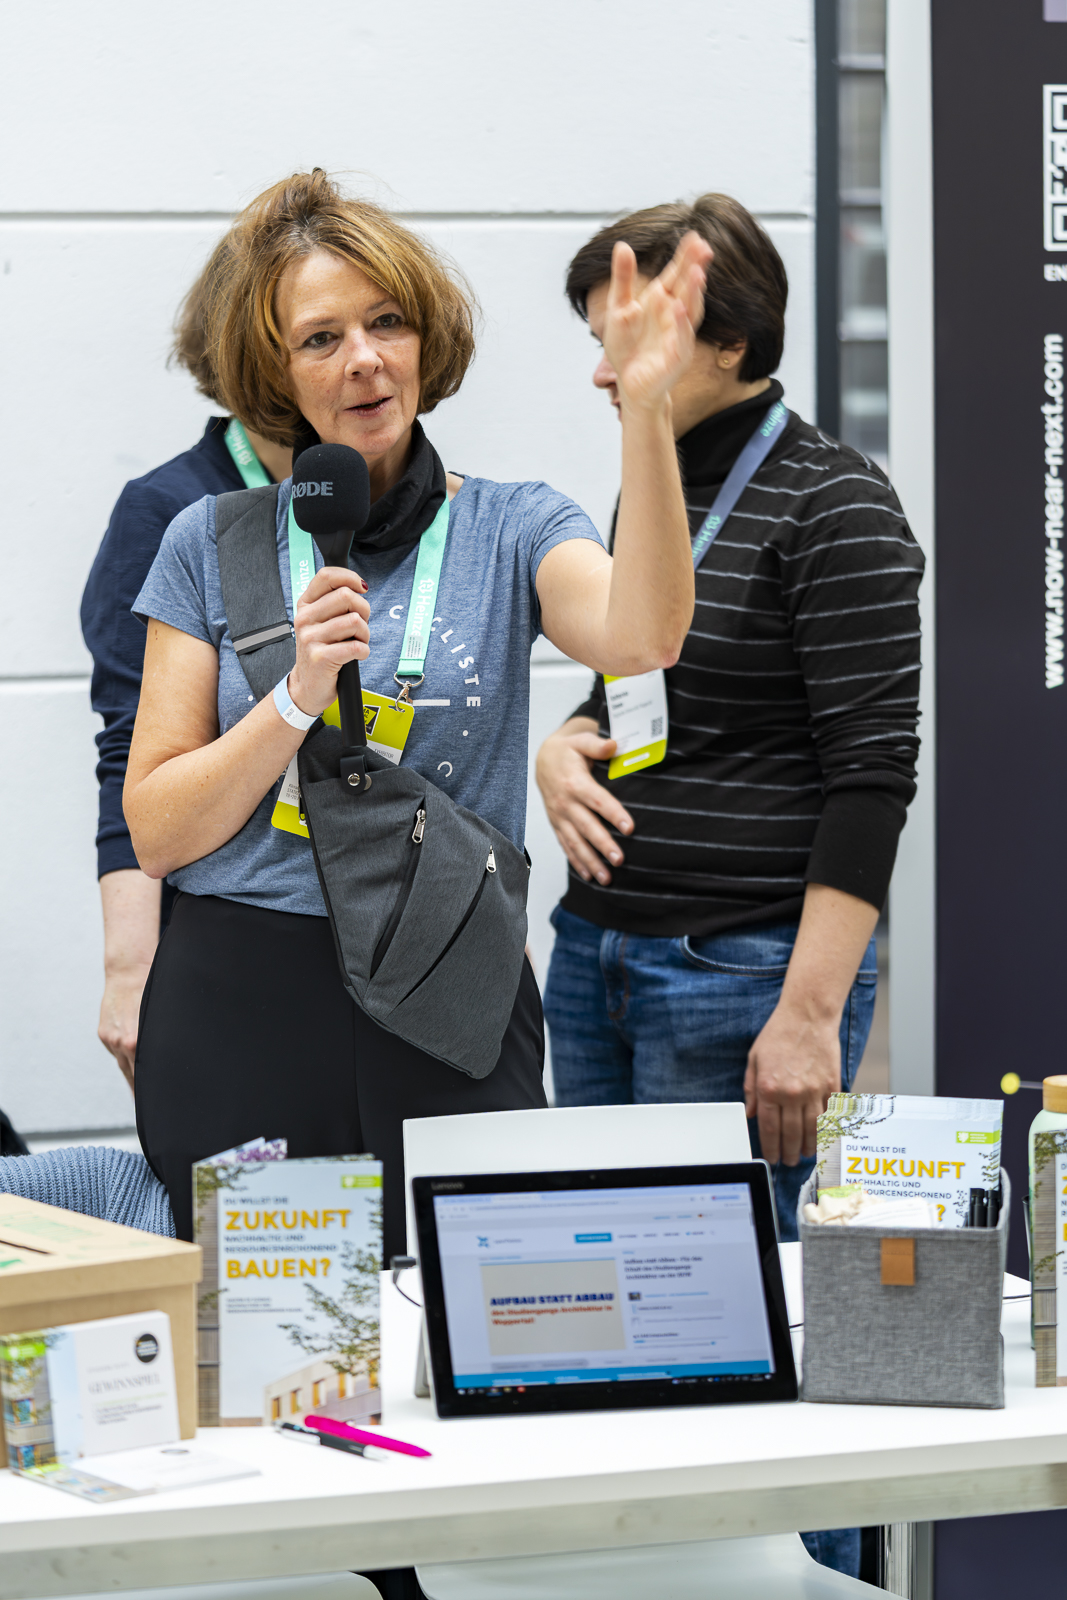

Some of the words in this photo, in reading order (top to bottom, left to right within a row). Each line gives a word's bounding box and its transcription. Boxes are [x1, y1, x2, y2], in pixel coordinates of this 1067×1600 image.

[291, 481, 334, 499] RØDE
[1041, 333, 1065, 689] www.now-near-next.com
[297, 560, 310, 596] einze
[411, 595, 432, 637] Heinze
[846, 1144, 858, 1152] DU
[860, 1145, 890, 1153] WILLST
[847, 1156, 965, 1179] ZUKUNFT
[845, 1178, 900, 1188] NACHHALTIG
[902, 1181, 921, 1189] UND
[866, 1188, 952, 1200] OURCENSCHONEND
[226, 1209, 351, 1230] ZUKUNFT
[227, 1258, 331, 1278] BAUEN?
[490, 1296, 537, 1307] AUFBAU
[538, 1294, 573, 1304] STATT
[575, 1292, 615, 1303] ABBAU
